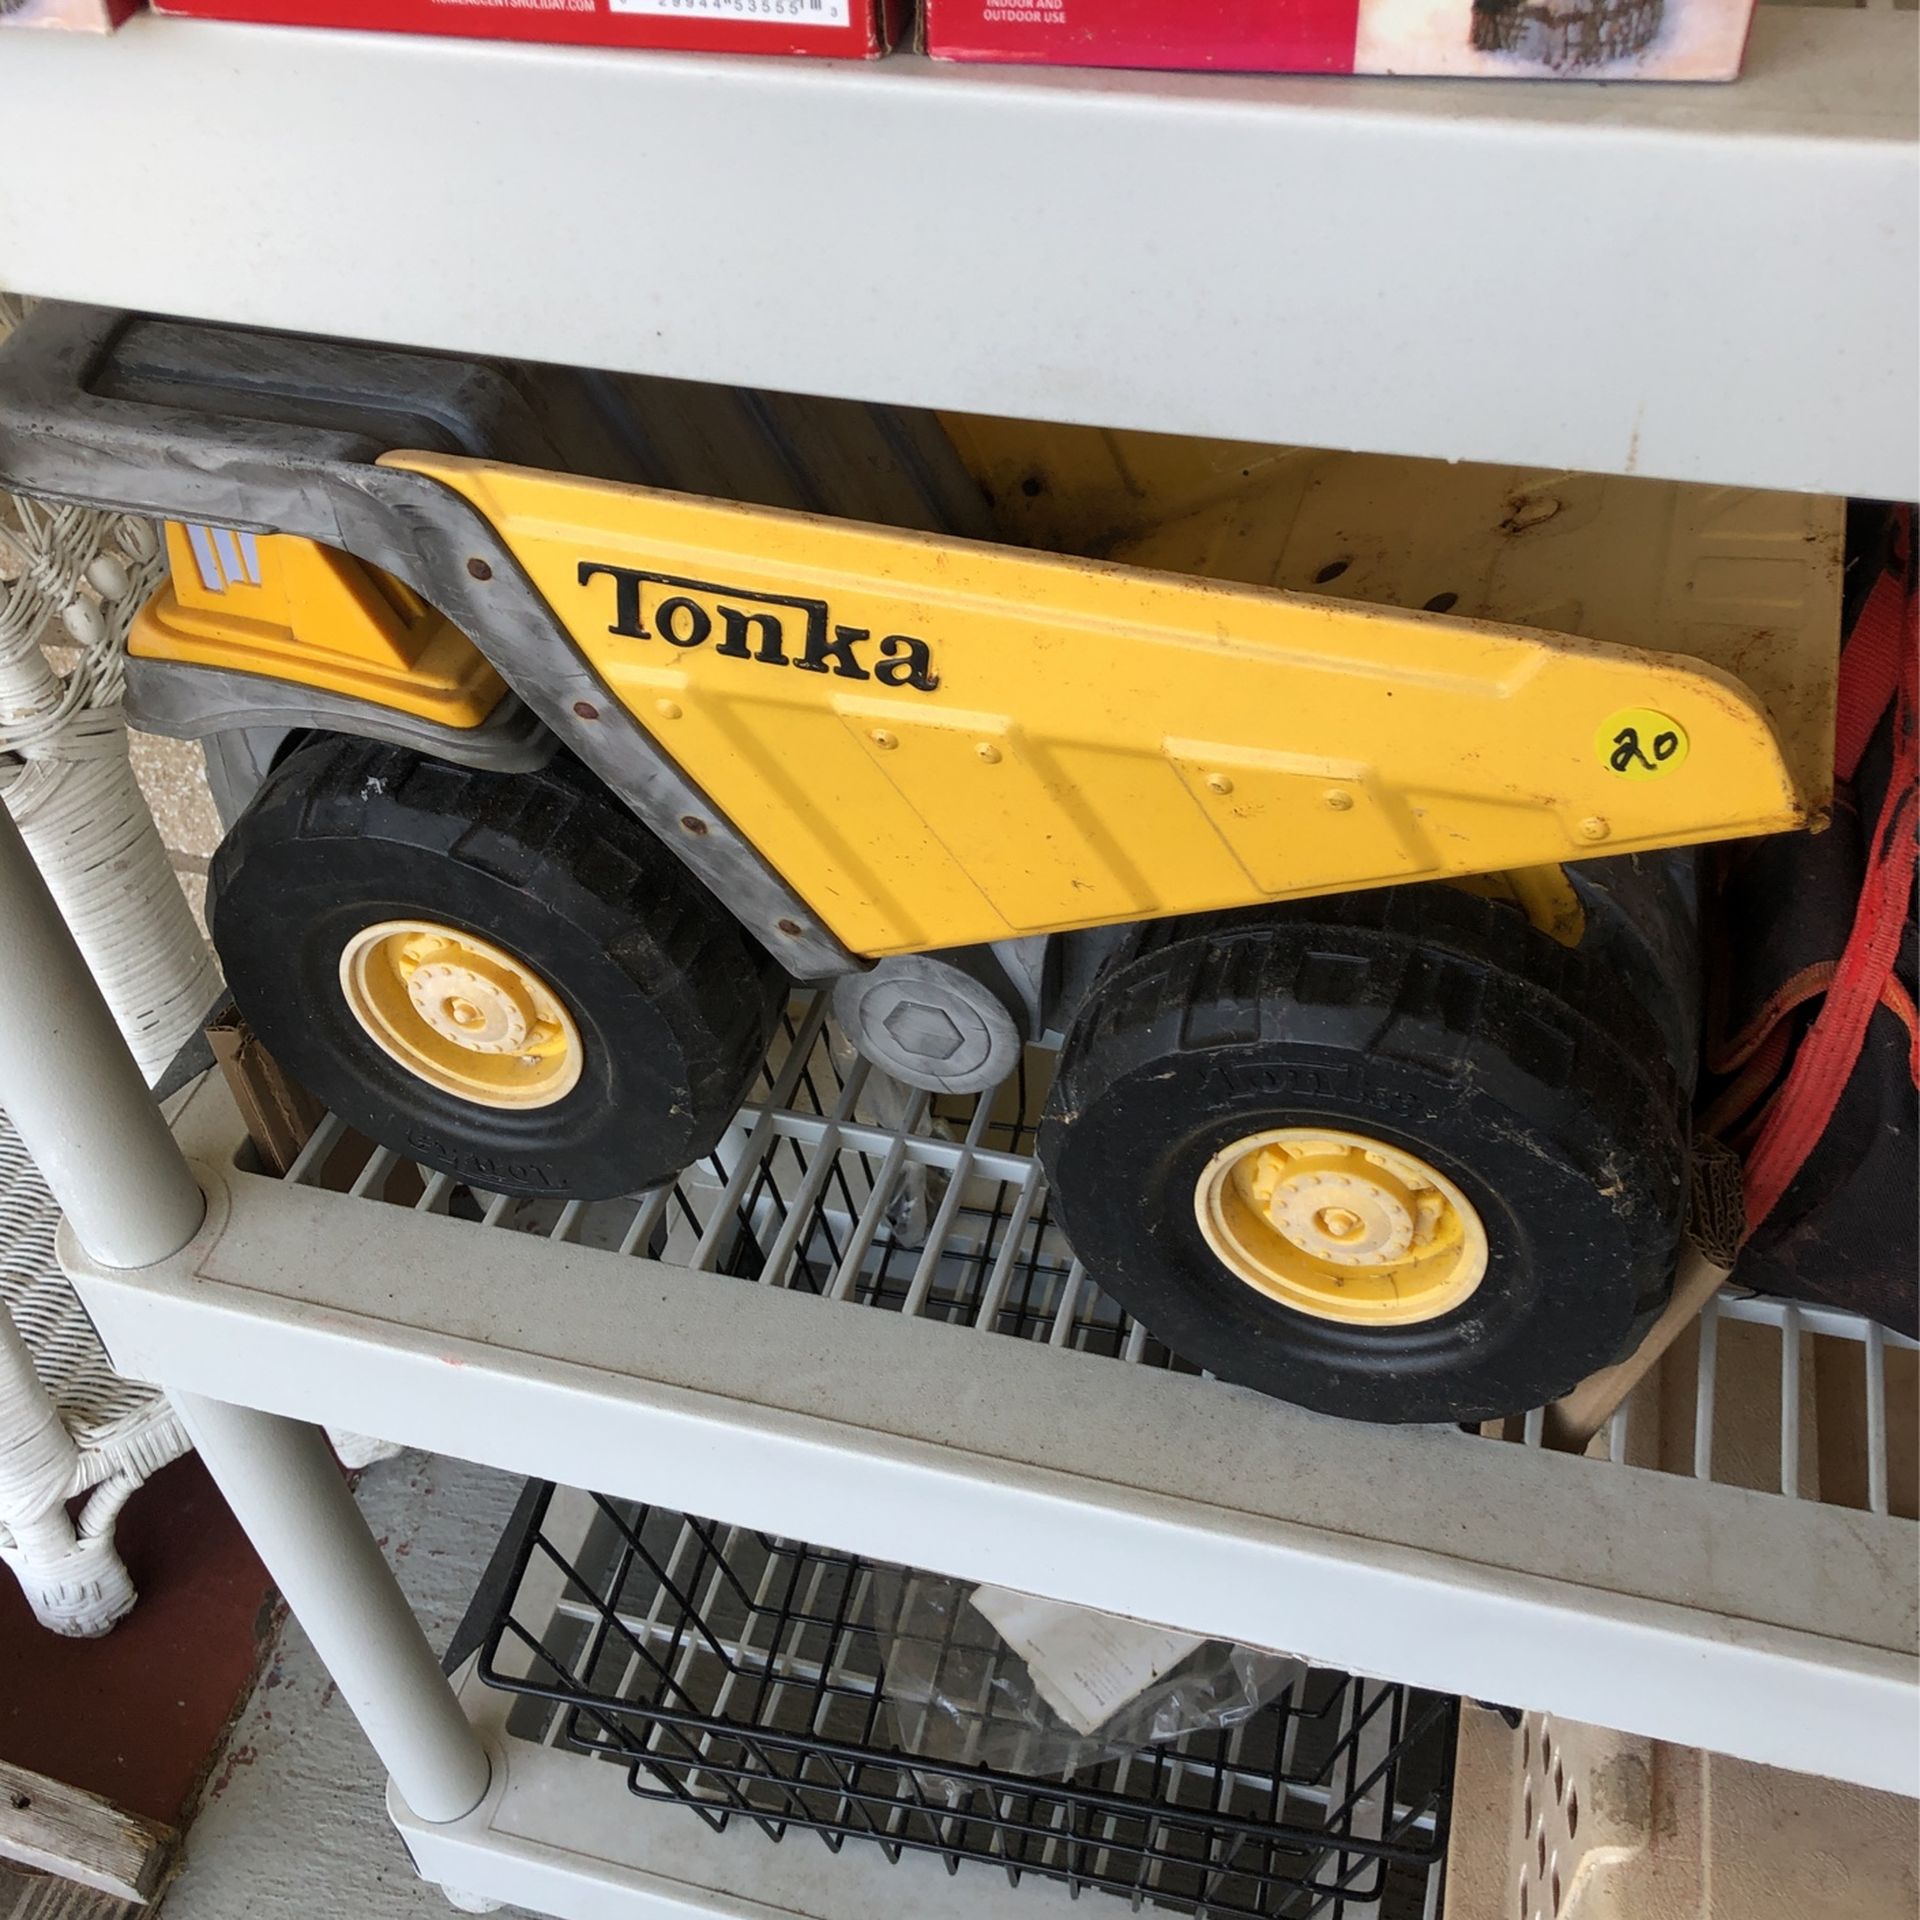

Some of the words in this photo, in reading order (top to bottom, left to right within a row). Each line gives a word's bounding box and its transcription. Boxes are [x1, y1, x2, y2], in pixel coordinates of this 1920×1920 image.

[432, 0, 595, 12] CENTSHOLIDAY.COM
[987, 0, 1033, 8] INDOOR
[1036, 0, 1062, 9] AND
[983, 9, 1041, 22] OUTDOOR
[1044, 11, 1066, 24] USE
[577, 561, 940, 692] Tonka
[1610, 727, 1679, 772] 20
